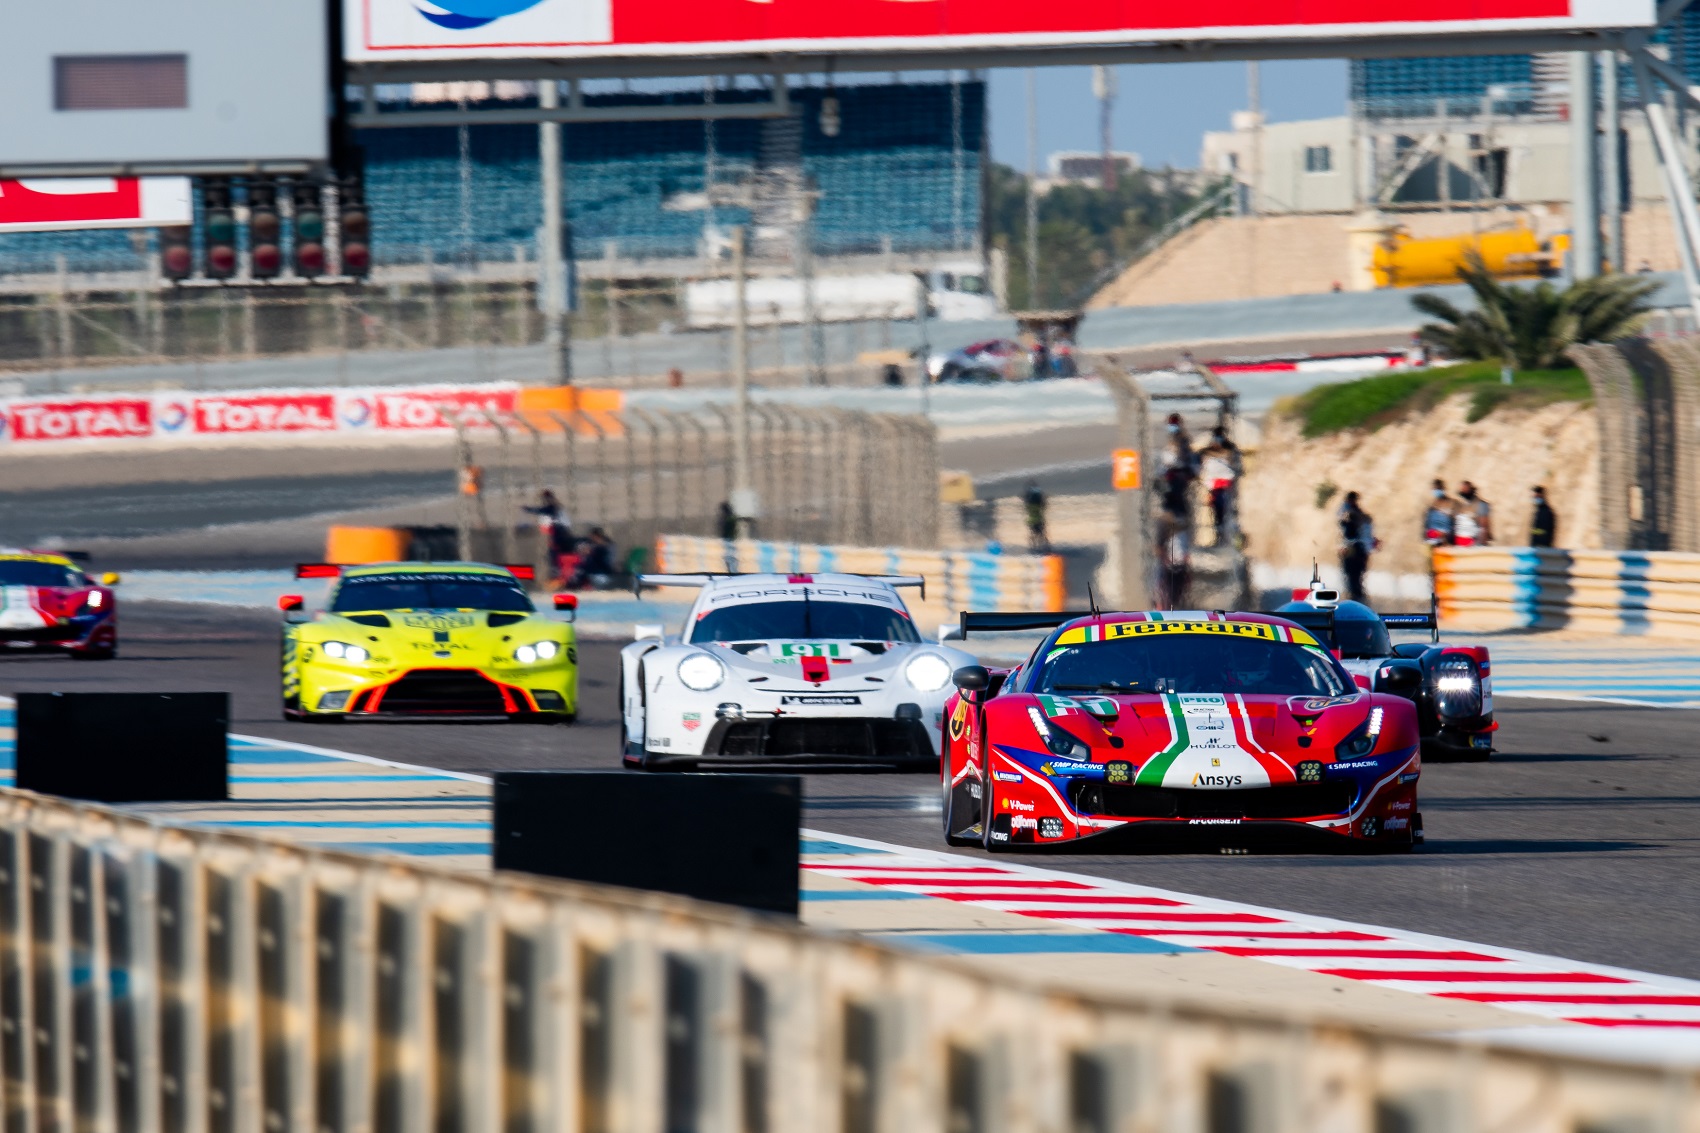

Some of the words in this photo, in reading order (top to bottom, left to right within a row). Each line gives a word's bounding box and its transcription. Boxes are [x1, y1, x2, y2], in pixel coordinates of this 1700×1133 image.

[17, 407, 151, 436] TOTAL
[202, 401, 331, 430] TOTAL
[711, 588, 893, 604] PORSCHE
[1111, 622, 1269, 638] Ferrari
[411, 641, 473, 651] TOTAL
[789, 643, 833, 657] 91
[1052, 761, 1071, 769] SMP
[1333, 762, 1351, 770] SMP
[1351, 760, 1379, 768] RACING
[1191, 772, 1243, 788] Ansys
[1009, 799, 1035, 811] V-Power
